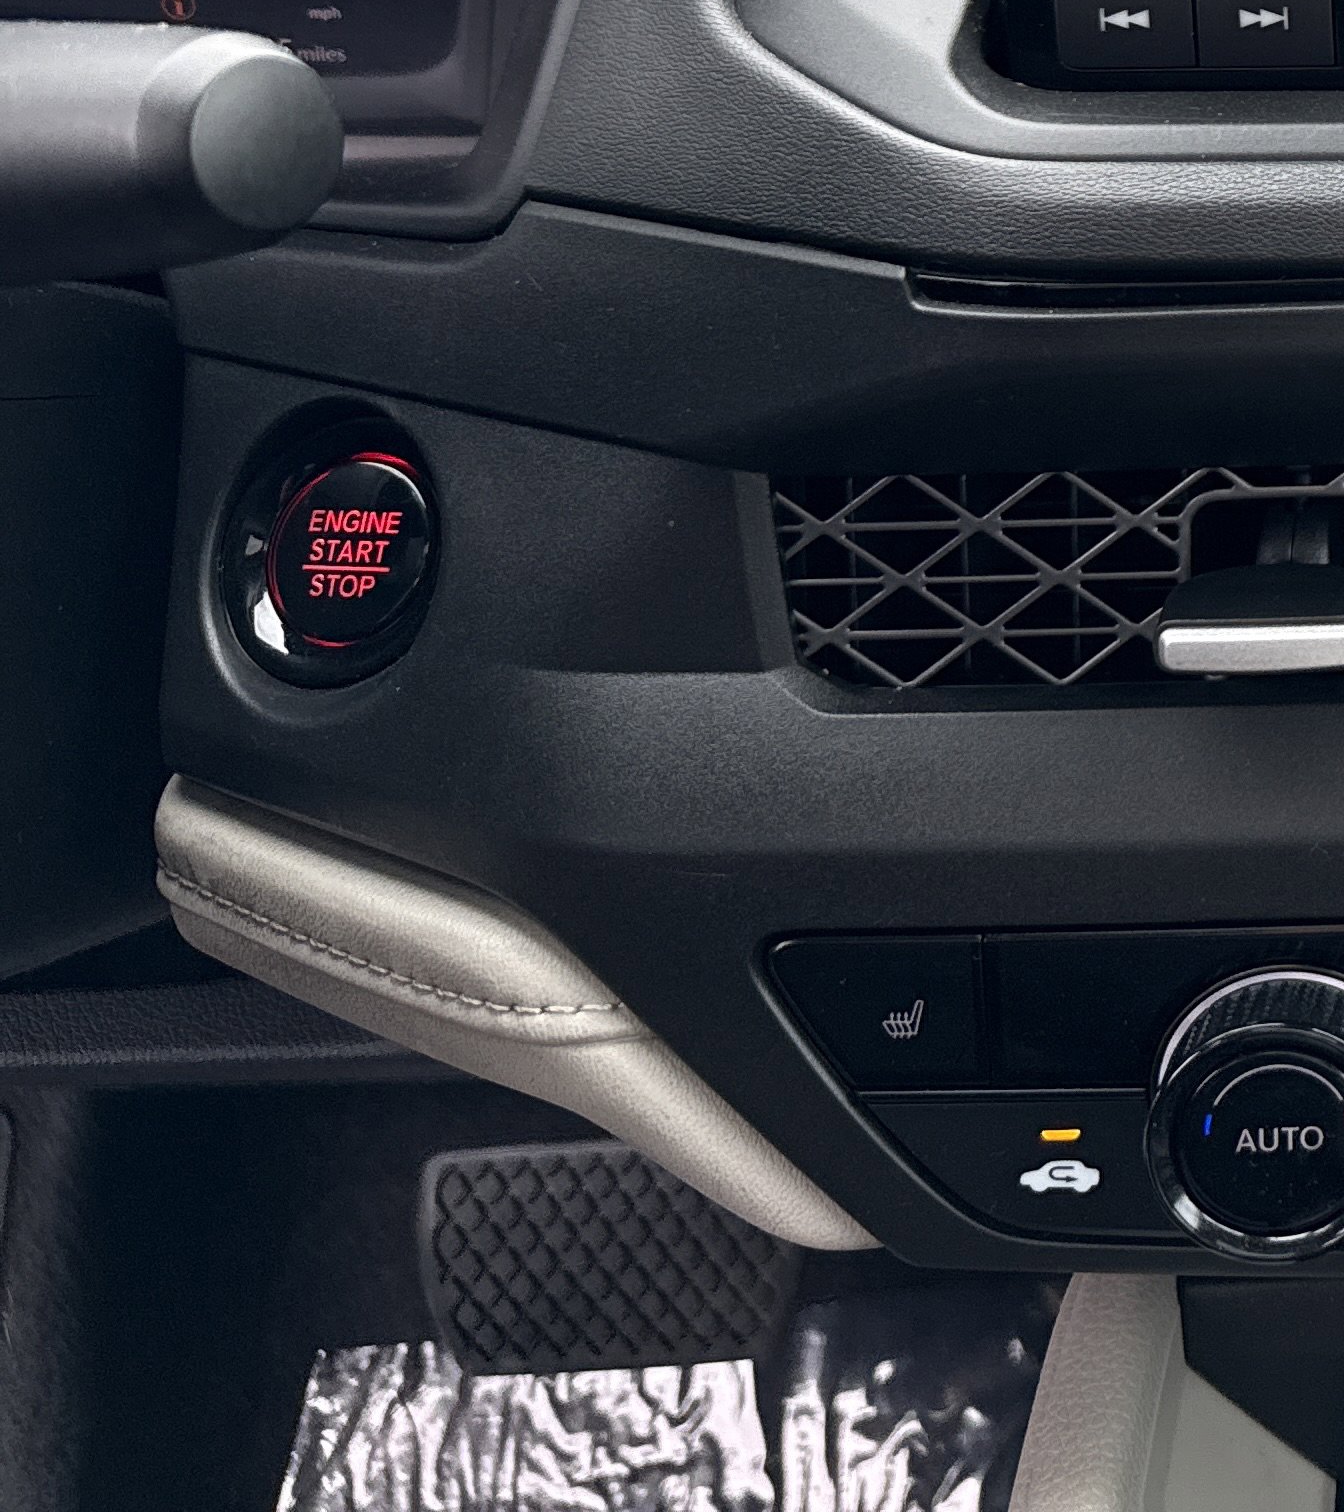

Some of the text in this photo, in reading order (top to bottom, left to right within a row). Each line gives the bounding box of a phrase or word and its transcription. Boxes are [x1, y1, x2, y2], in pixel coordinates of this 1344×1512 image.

[307, 6, 342, 21] mph
[296, 46, 347, 62] miles
[309, 509, 402, 534] ENGINE
[309, 537, 389, 563] START
[309, 573, 376, 598] STOP
[1235, 1125, 1324, 1153] AUTO
